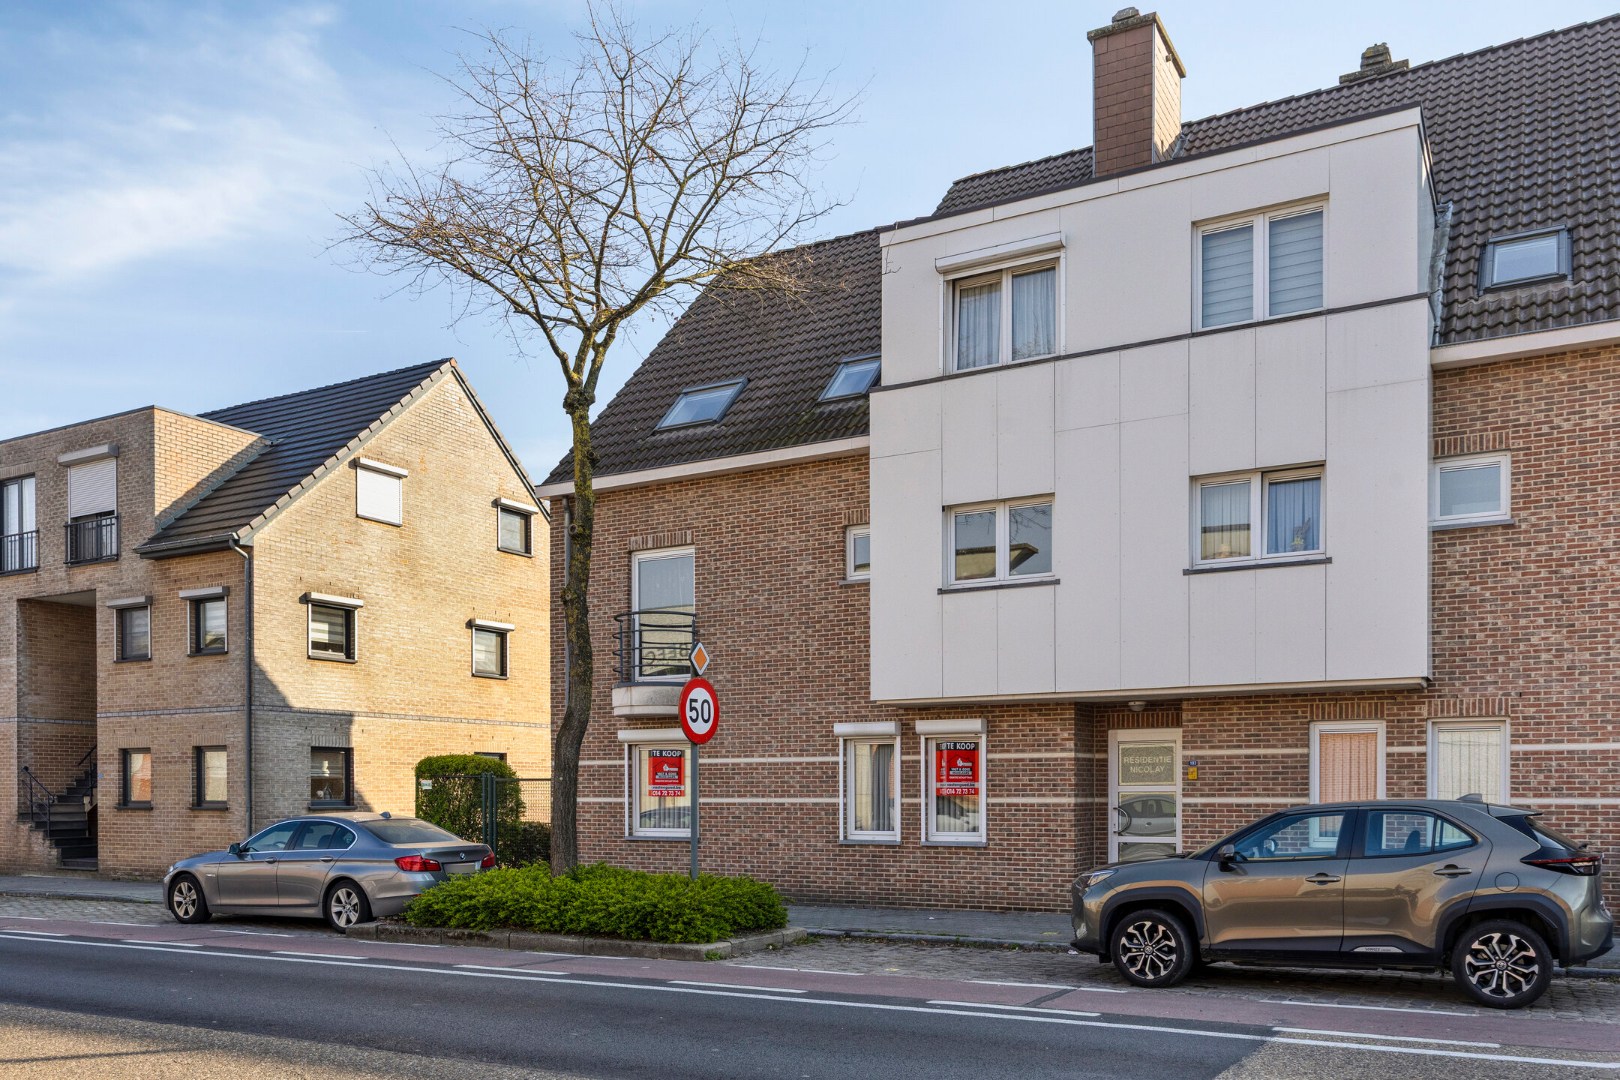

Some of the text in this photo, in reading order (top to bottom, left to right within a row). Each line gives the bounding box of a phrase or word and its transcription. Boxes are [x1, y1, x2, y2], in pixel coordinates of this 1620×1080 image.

[689, 698, 711, 724] 50
[1123, 755, 1172, 764] RESIDENTIE
[1130, 765, 1165, 774] NICOLAY
